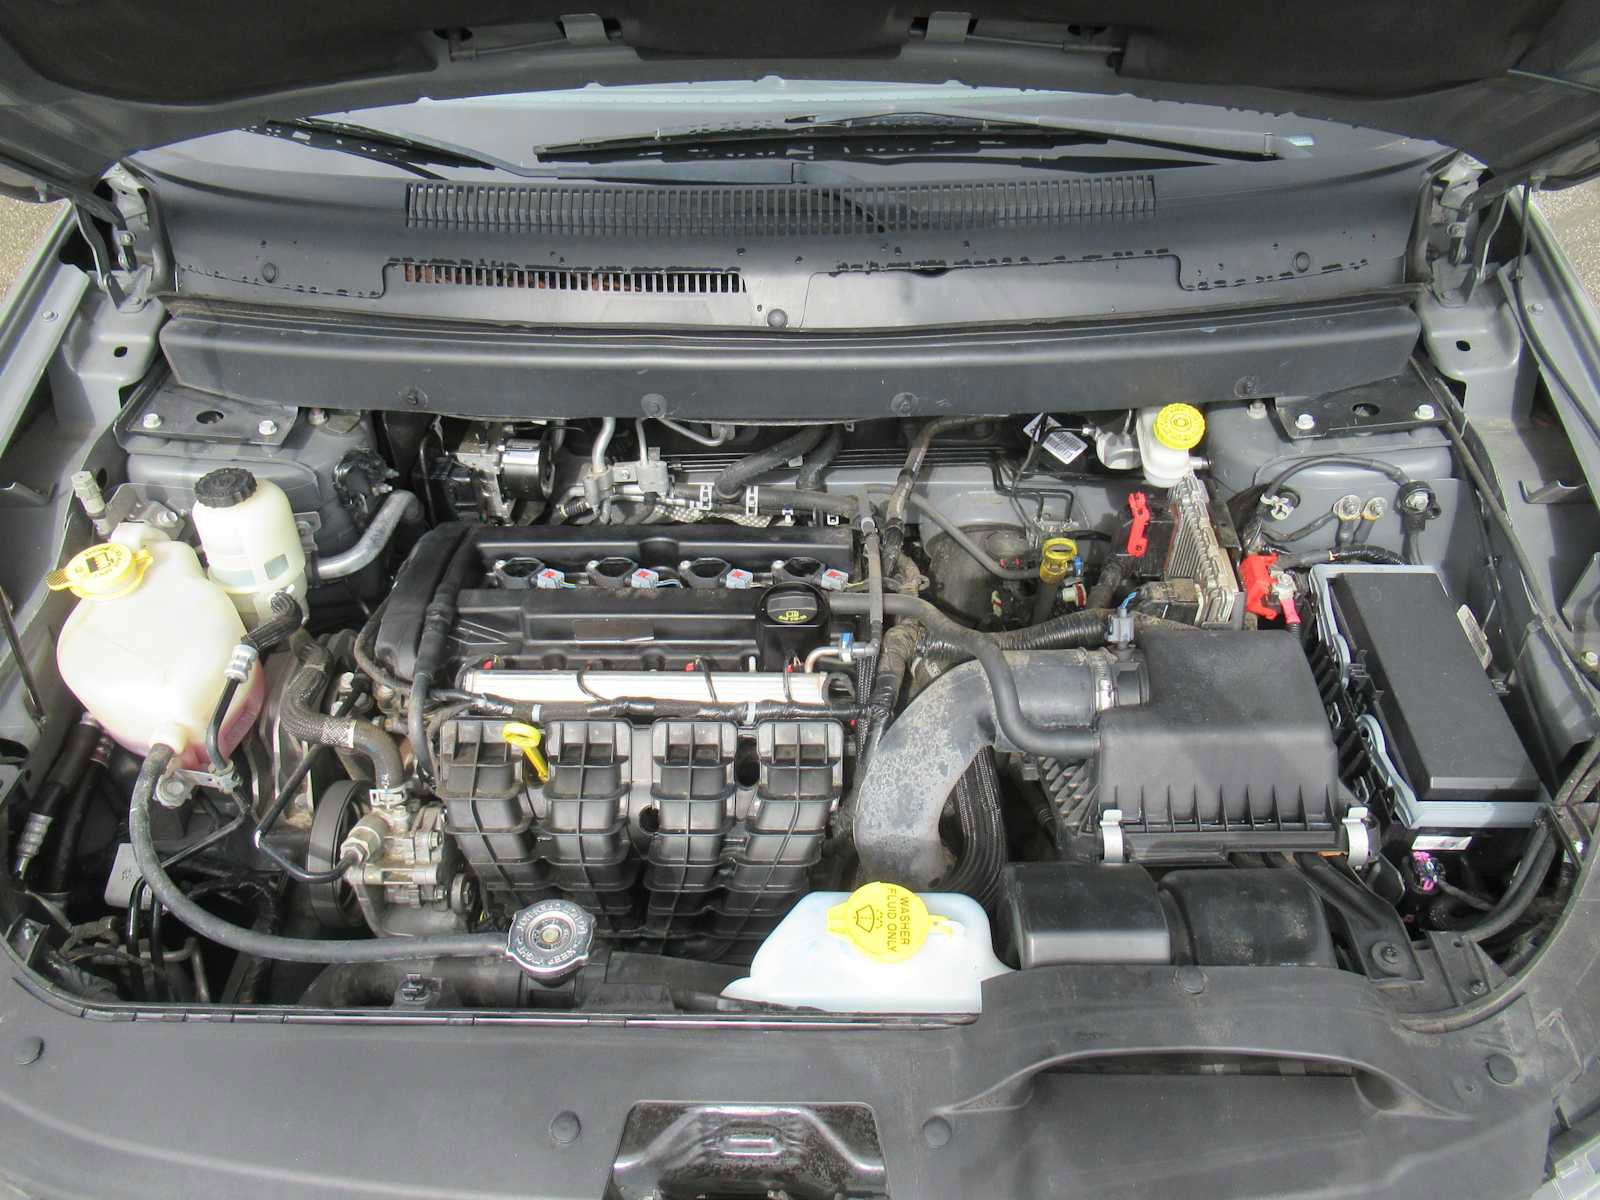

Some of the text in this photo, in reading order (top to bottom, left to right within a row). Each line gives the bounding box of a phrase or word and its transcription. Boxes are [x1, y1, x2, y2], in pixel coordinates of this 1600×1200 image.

[887, 888, 897, 952] FLUID ONLY
[900, 897, 910, 945] WASHER
